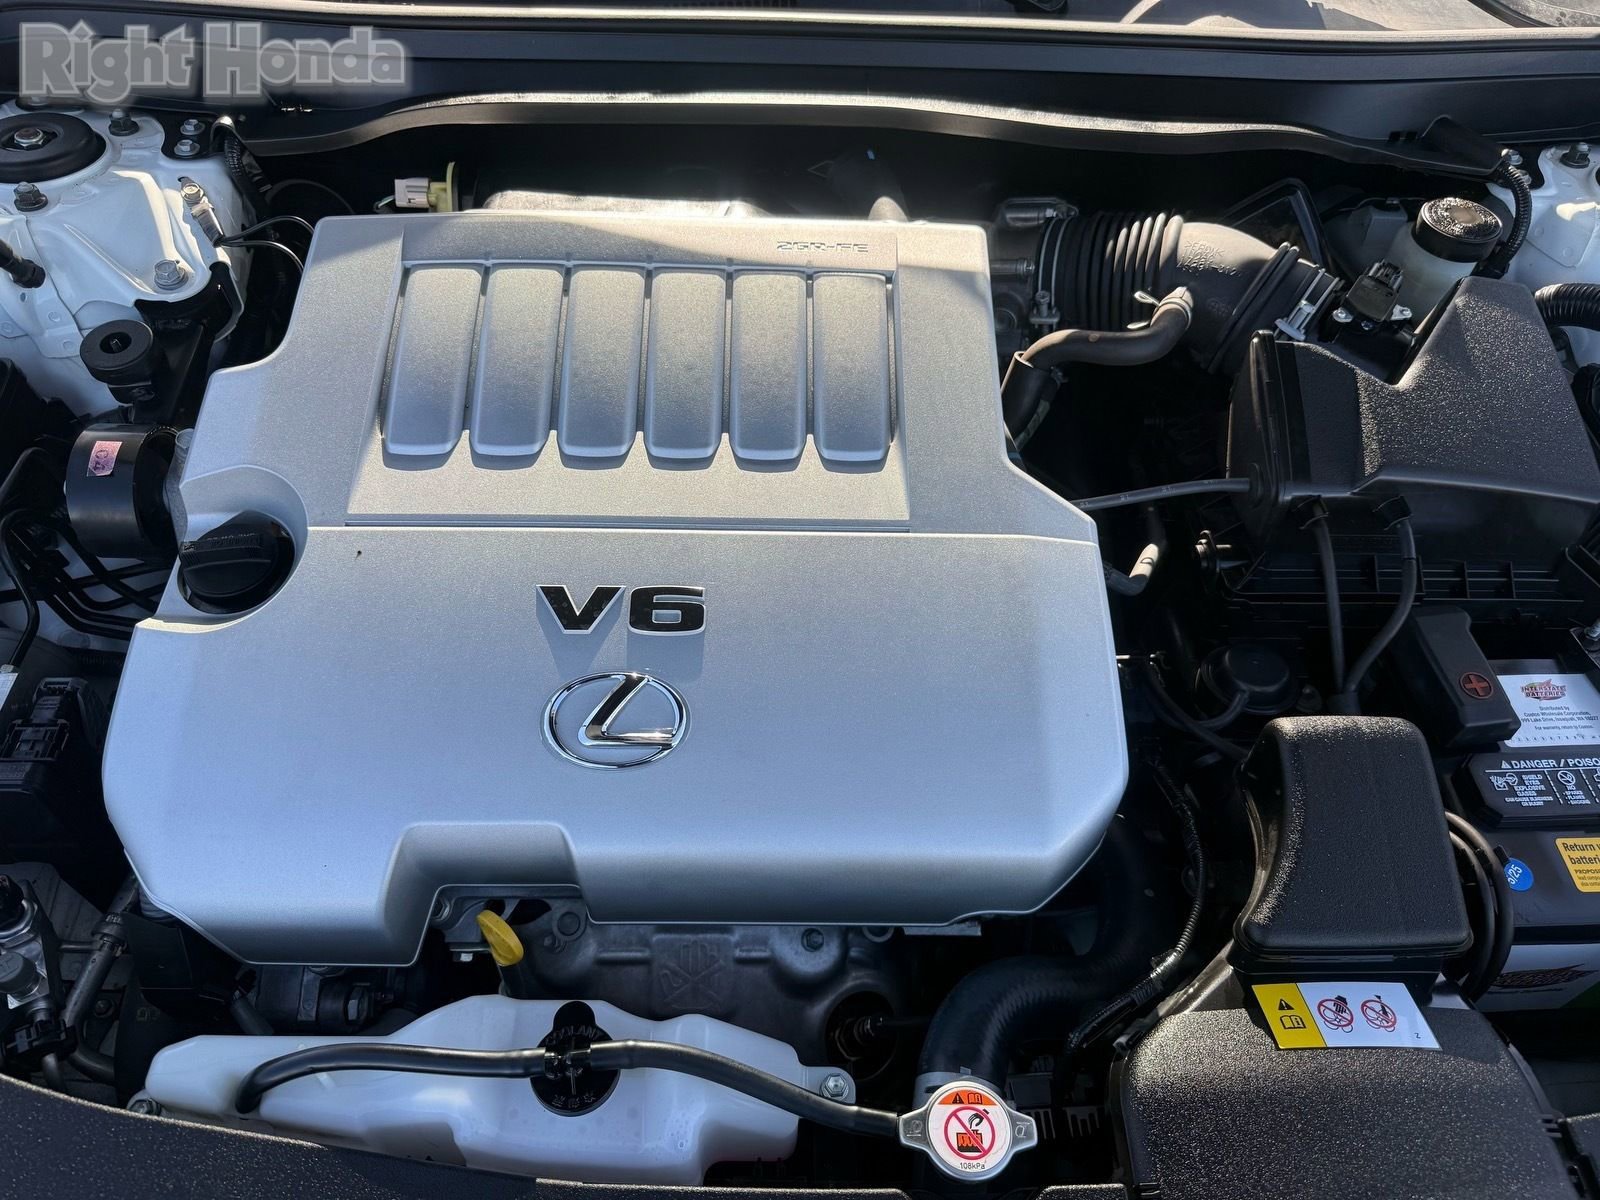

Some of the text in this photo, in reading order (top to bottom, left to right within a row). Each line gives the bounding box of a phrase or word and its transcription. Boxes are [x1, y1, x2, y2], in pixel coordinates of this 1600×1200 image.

[776, 240, 869, 253] 2GR-FE
[535, 584, 707, 637] V6
[1511, 760, 1558, 769] DANGER
[1566, 758, 1600, 767] POISO
[1562, 842, 1596, 852] Return
[1568, 854, 1600, 865] batteri
[959, 1162, 986, 1170] 108kPa
